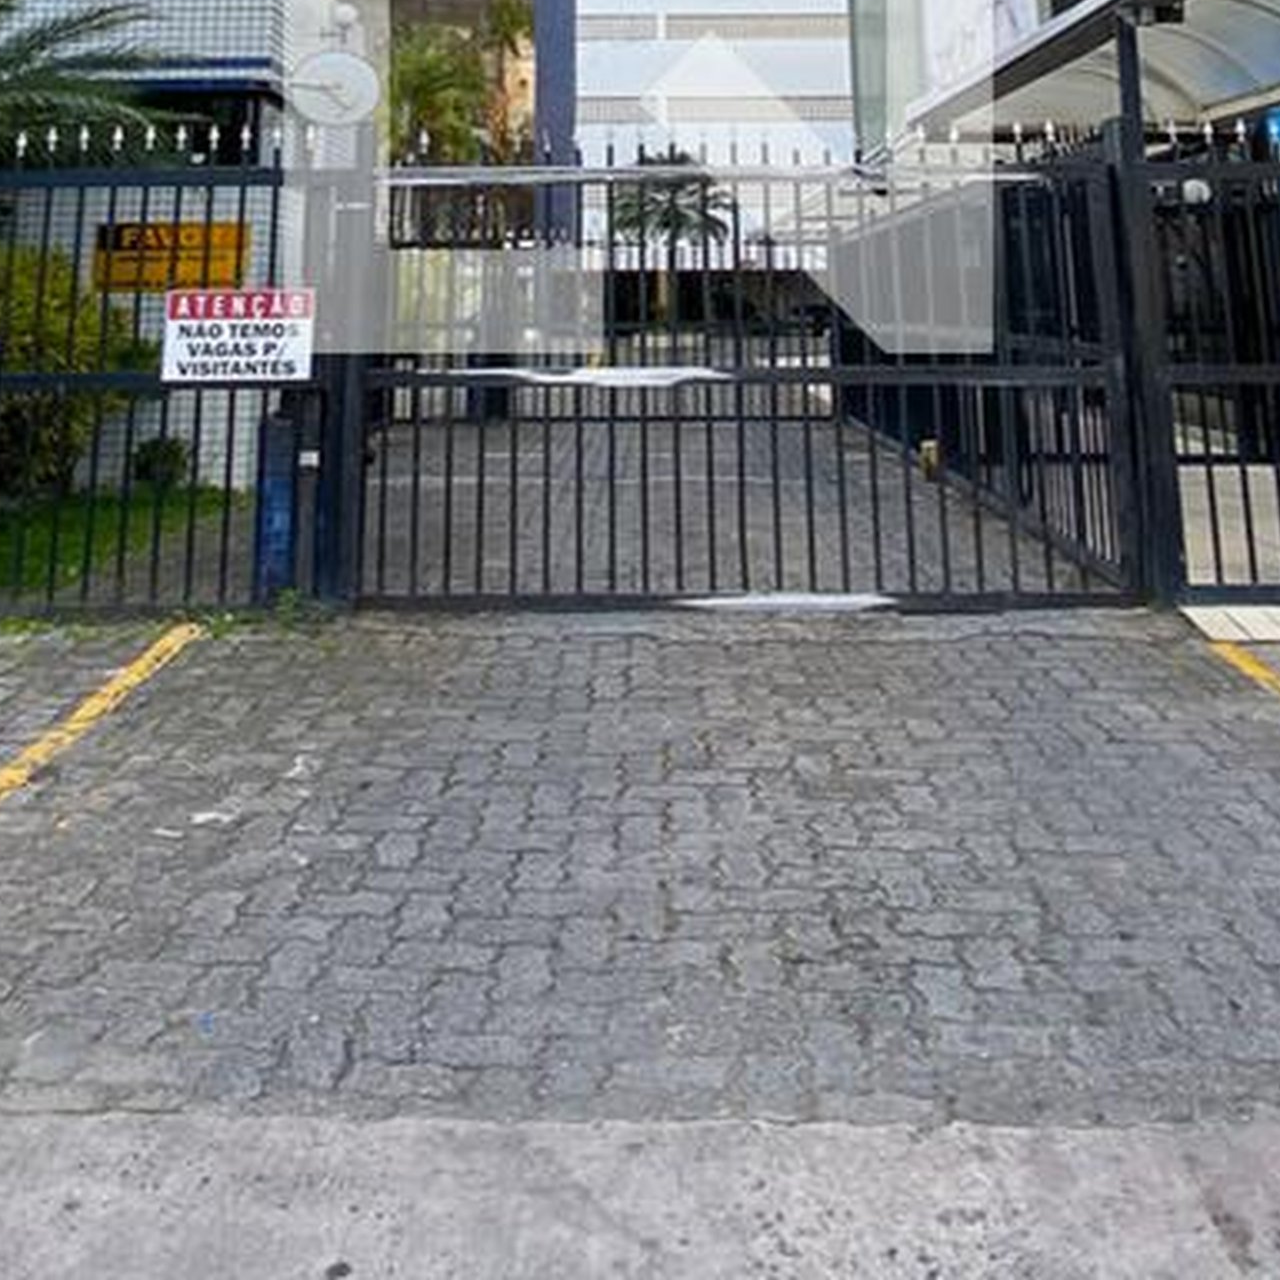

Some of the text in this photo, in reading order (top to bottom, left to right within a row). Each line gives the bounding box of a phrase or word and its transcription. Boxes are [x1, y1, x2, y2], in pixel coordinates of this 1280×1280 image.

[227, 322, 301, 339] TEMOS
[186, 341, 257, 357] VAGAS
[176, 360, 297, 376] VISITANTES
